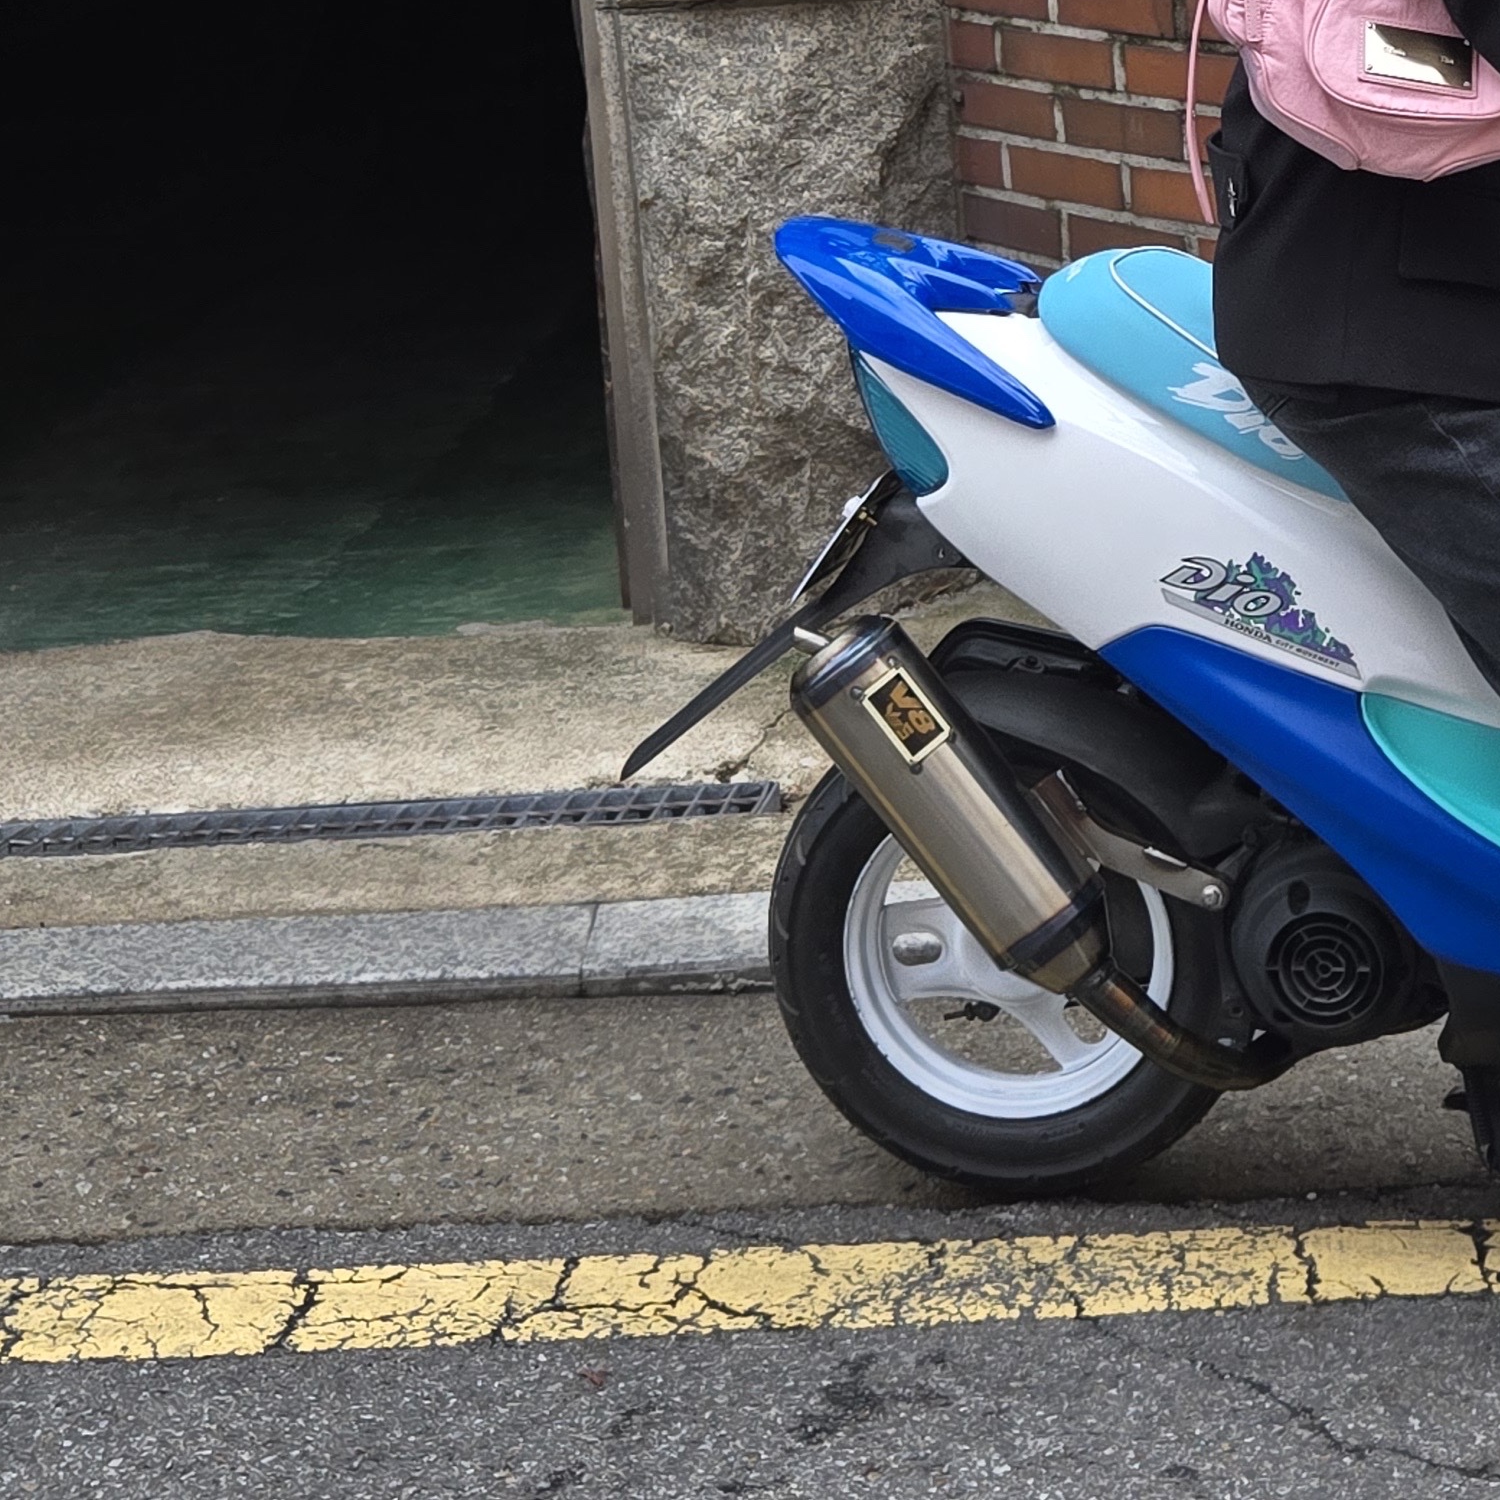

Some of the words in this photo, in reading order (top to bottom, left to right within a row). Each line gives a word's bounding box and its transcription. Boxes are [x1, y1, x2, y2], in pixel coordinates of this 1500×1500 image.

[1160, 556, 1284, 618] Dio
[1223, 617, 1273, 644] HONDA
[889, 680, 936, 735] V8
